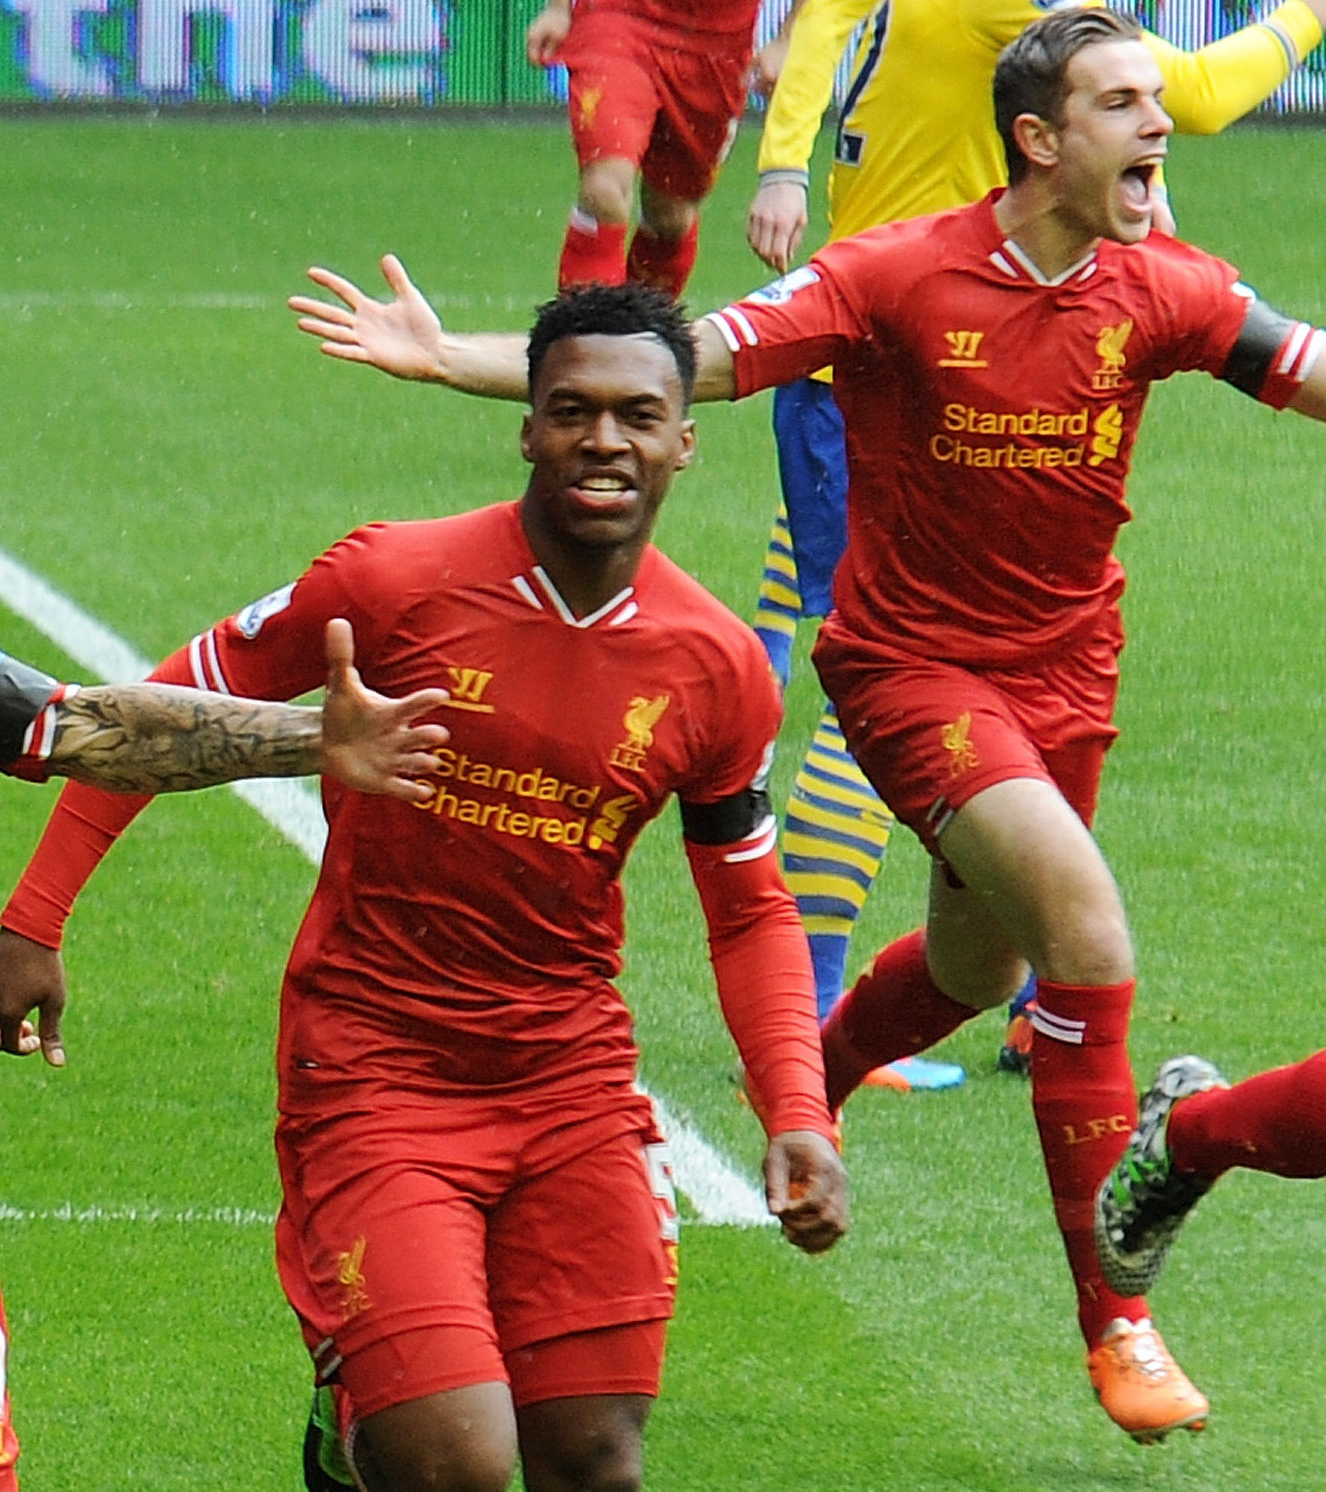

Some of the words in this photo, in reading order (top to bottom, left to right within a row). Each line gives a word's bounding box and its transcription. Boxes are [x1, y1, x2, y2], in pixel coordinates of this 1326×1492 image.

[943, 403, 1089, 436] Standard
[930, 433, 1085, 468] Chartered
[431, 747, 602, 809] Standard
[411, 777, 588, 846] Chartered
